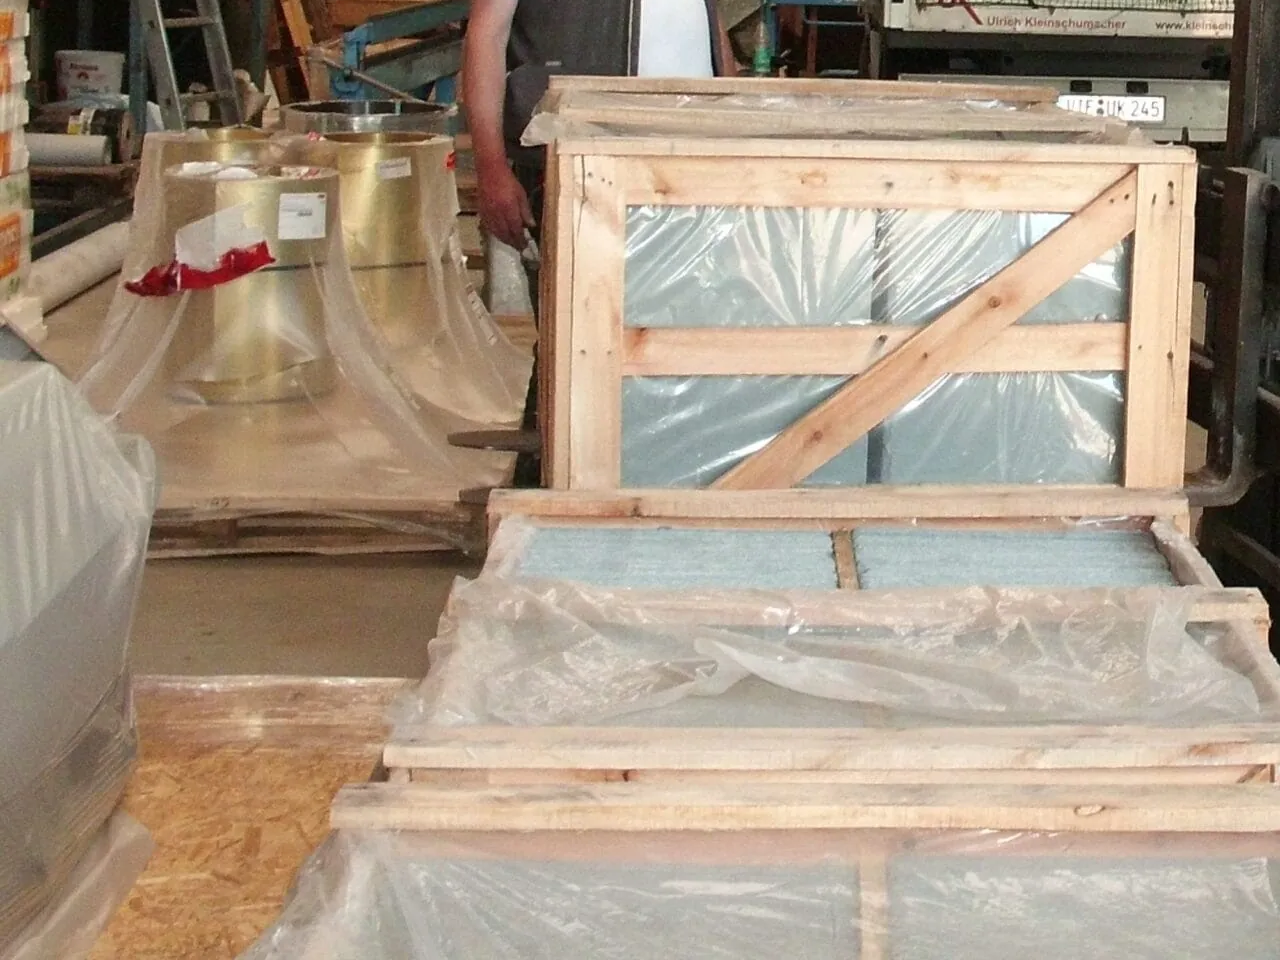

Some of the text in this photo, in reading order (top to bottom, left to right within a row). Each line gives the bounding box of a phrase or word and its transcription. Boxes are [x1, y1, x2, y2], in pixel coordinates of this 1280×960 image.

[987, 16, 1126, 30] Ulrich Kleinschumacher
[1131, 101, 1160, 117] 245
